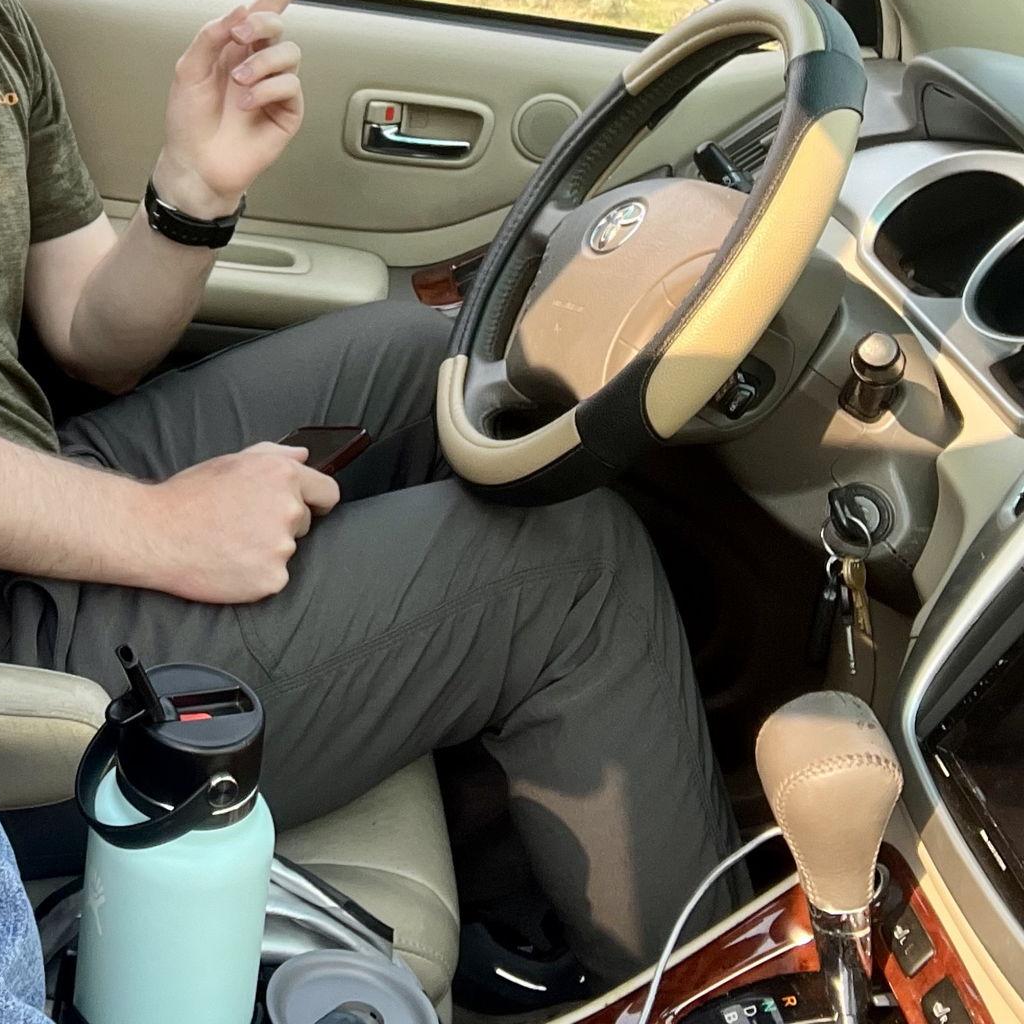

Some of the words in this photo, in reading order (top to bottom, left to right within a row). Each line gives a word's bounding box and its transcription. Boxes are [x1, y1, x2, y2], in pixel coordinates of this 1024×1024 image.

[762, 998, 775, 1012] N
[782, 996, 797, 1007] R
[743, 1005, 757, 1017] D
[724, 1011, 738, 1024] B
